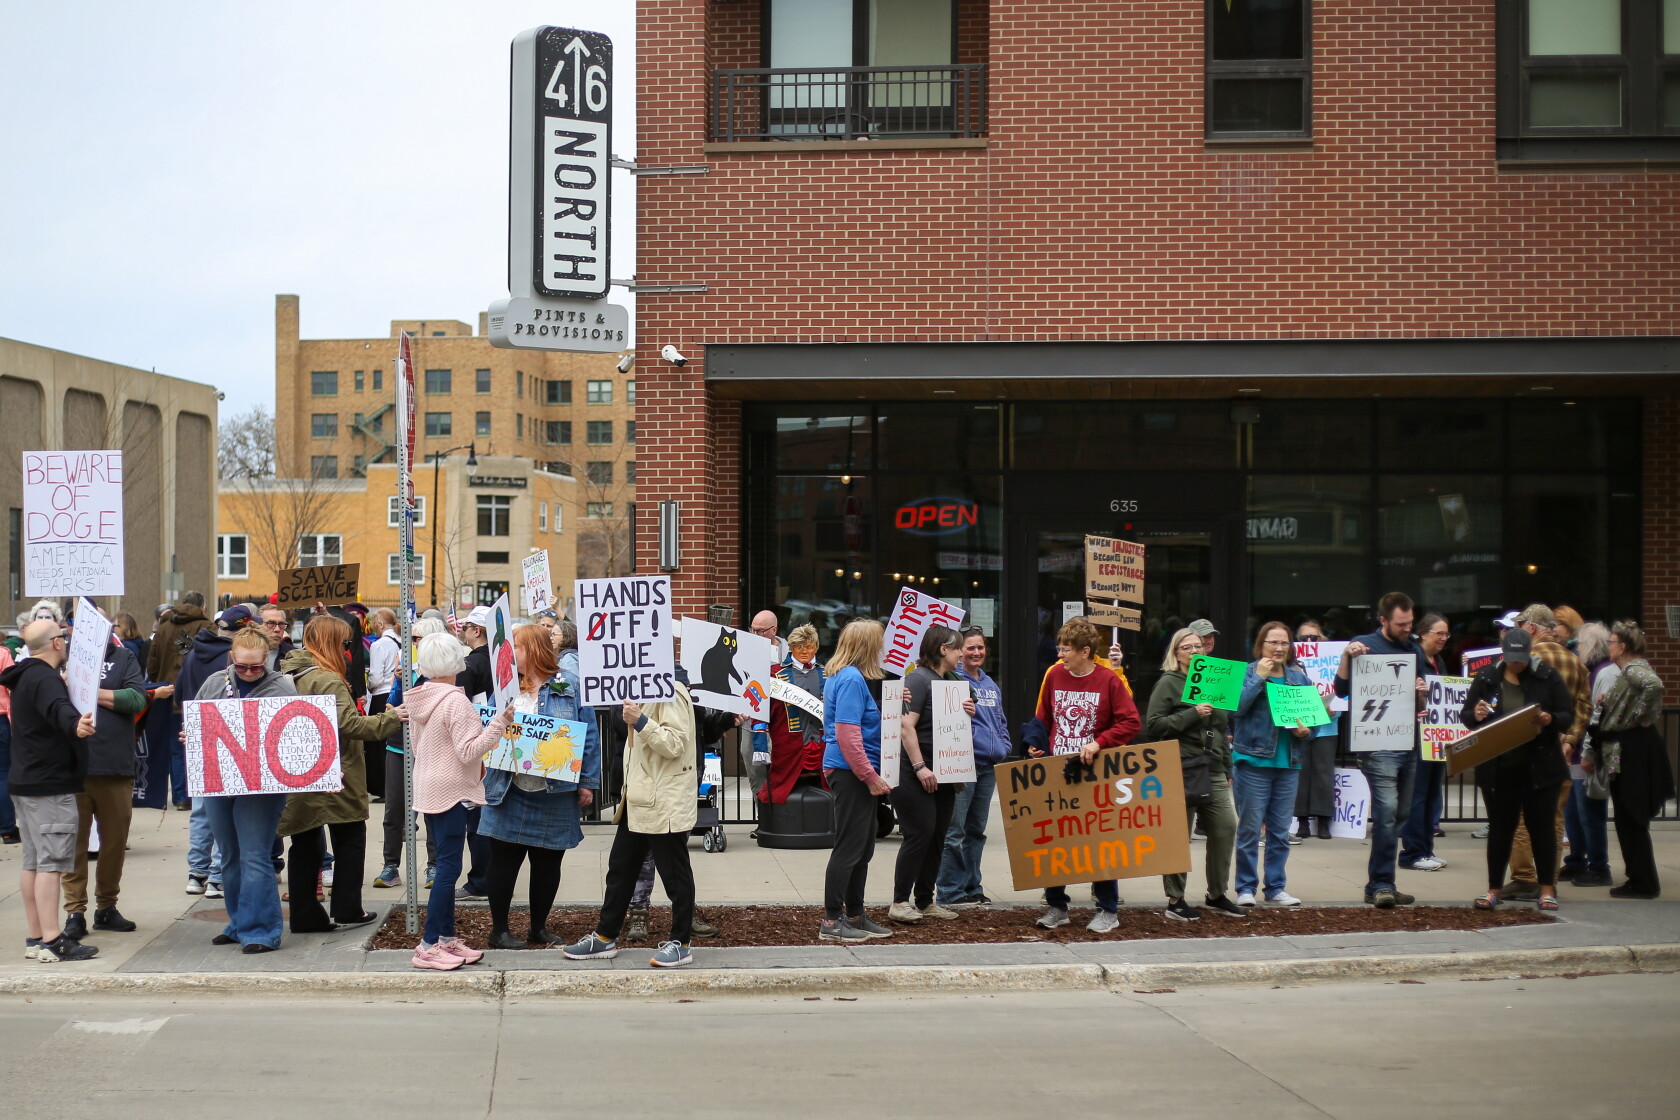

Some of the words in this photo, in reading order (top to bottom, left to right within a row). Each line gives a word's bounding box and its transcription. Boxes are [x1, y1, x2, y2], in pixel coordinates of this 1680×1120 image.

[553, 129, 598, 285] NORTH
[533, 308, 588, 323] PINTS
[596, 313, 606, 325] &
[514, 323, 624, 342] PROVISIONS
[26, 453, 122, 485] BEWARE
[52, 484, 90, 511] OF
[1110, 500, 1138, 512] 635
[895, 504, 978, 528] OPEN
[27, 511, 117, 541] DOGE
[1089, 538, 1111, 547] WHEN
[28, 545, 113, 567] AMERICA
[28, 567, 64, 579] NEEDS
[69, 566, 112, 577] NATIONAL
[291, 565, 347, 586] SAVE
[1099, 564, 1145, 580] RESISTANCE
[39, 577, 105, 594] PARKS!!
[279, 581, 356, 603] SCIENCE
[580, 580, 666, 608] HANDS
[602, 642, 655, 669] DUE
[1295, 642, 1319, 659] NLY
[1193, 658, 1232, 675] Greed
[1356, 658, 1384, 676] NEW
[584, 673, 675, 702] PROCESS
[781, 687, 804, 704] King
[1188, 685, 1227, 704] People
[1277, 687, 1302, 698] HATE
[1360, 684, 1407, 697] MODEL
[1427, 681, 1442, 705] NO
[186, 700, 237, 713] KINGS
[324, 695, 336, 707] BS
[945, 685, 960, 715] NO
[229, 708, 275, 719] FEDERAL
[279, 706, 328, 717] WORKERS
[1423, 708, 1439, 724] NO
[1445, 708, 1463, 724] KIN
[522, 715, 557, 729] LANDS
[1386, 723, 1414, 736] NAZIS
[300, 734, 332, 745] PARKS
[304, 728, 332, 739] BIRTH
[525, 728, 550, 742] SALE
[953, 733, 961, 742] to
[1423, 728, 1455, 741] SPREAD
[200, 698, 337, 793] NO
[305, 743, 340, 754] CAMPS
[289, 752, 339, 762] DICTATORS
[188, 764, 239, 775] ERASING
[282, 759, 329, 771] HISTORY
[188, 773, 231, 783] CUTTING
[1011, 763, 1046, 793] NO
[189, 788, 227, 798] TAKING
[228, 787, 254, 796] OVER
[307, 782, 341, 792] PANAMA
[1009, 799, 1031, 820] In
[1044, 791, 1080, 812] the
[1093, 775, 1163, 808] USA
[1033, 805, 1162, 845] IMPEACH
[1024, 835, 1156, 877] TRUMP
